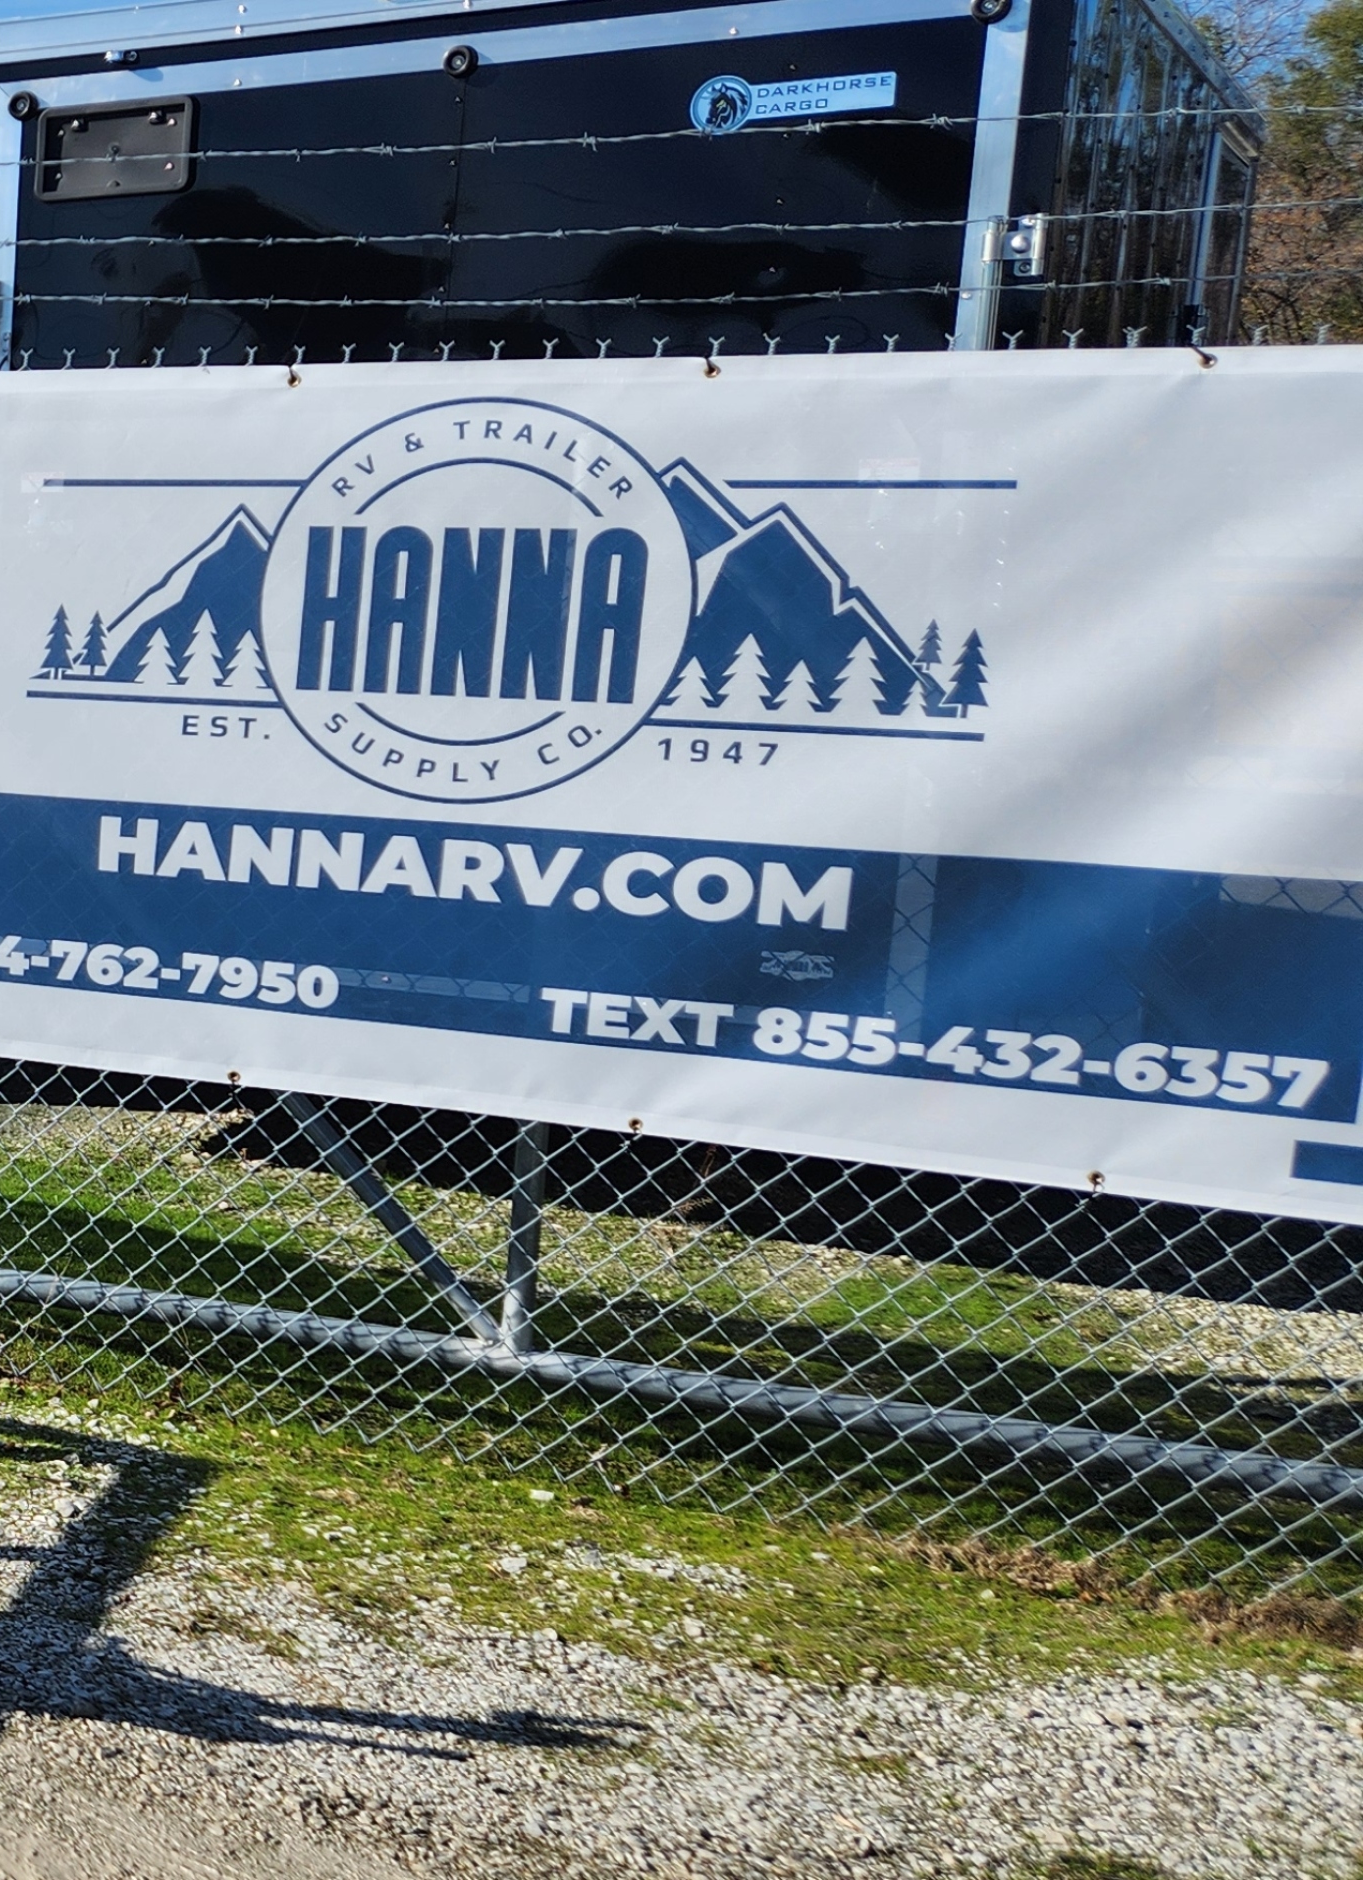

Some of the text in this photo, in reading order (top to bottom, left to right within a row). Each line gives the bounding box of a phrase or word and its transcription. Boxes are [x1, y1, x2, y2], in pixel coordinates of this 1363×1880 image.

[755, 98, 828, 115] CARGO
[757, 75, 893, 98] DARKHORSE
[331, 420, 633, 499] RV & TRAILER
[296, 525, 649, 704] HANNA
[181, 715, 779, 767] EST. 1947
[324, 712, 603, 783] SUPPLY CO.
[96, 814, 855, 931] HANNARV.COM
[541, 988, 1330, 1108] TEXT 855-432-6357
